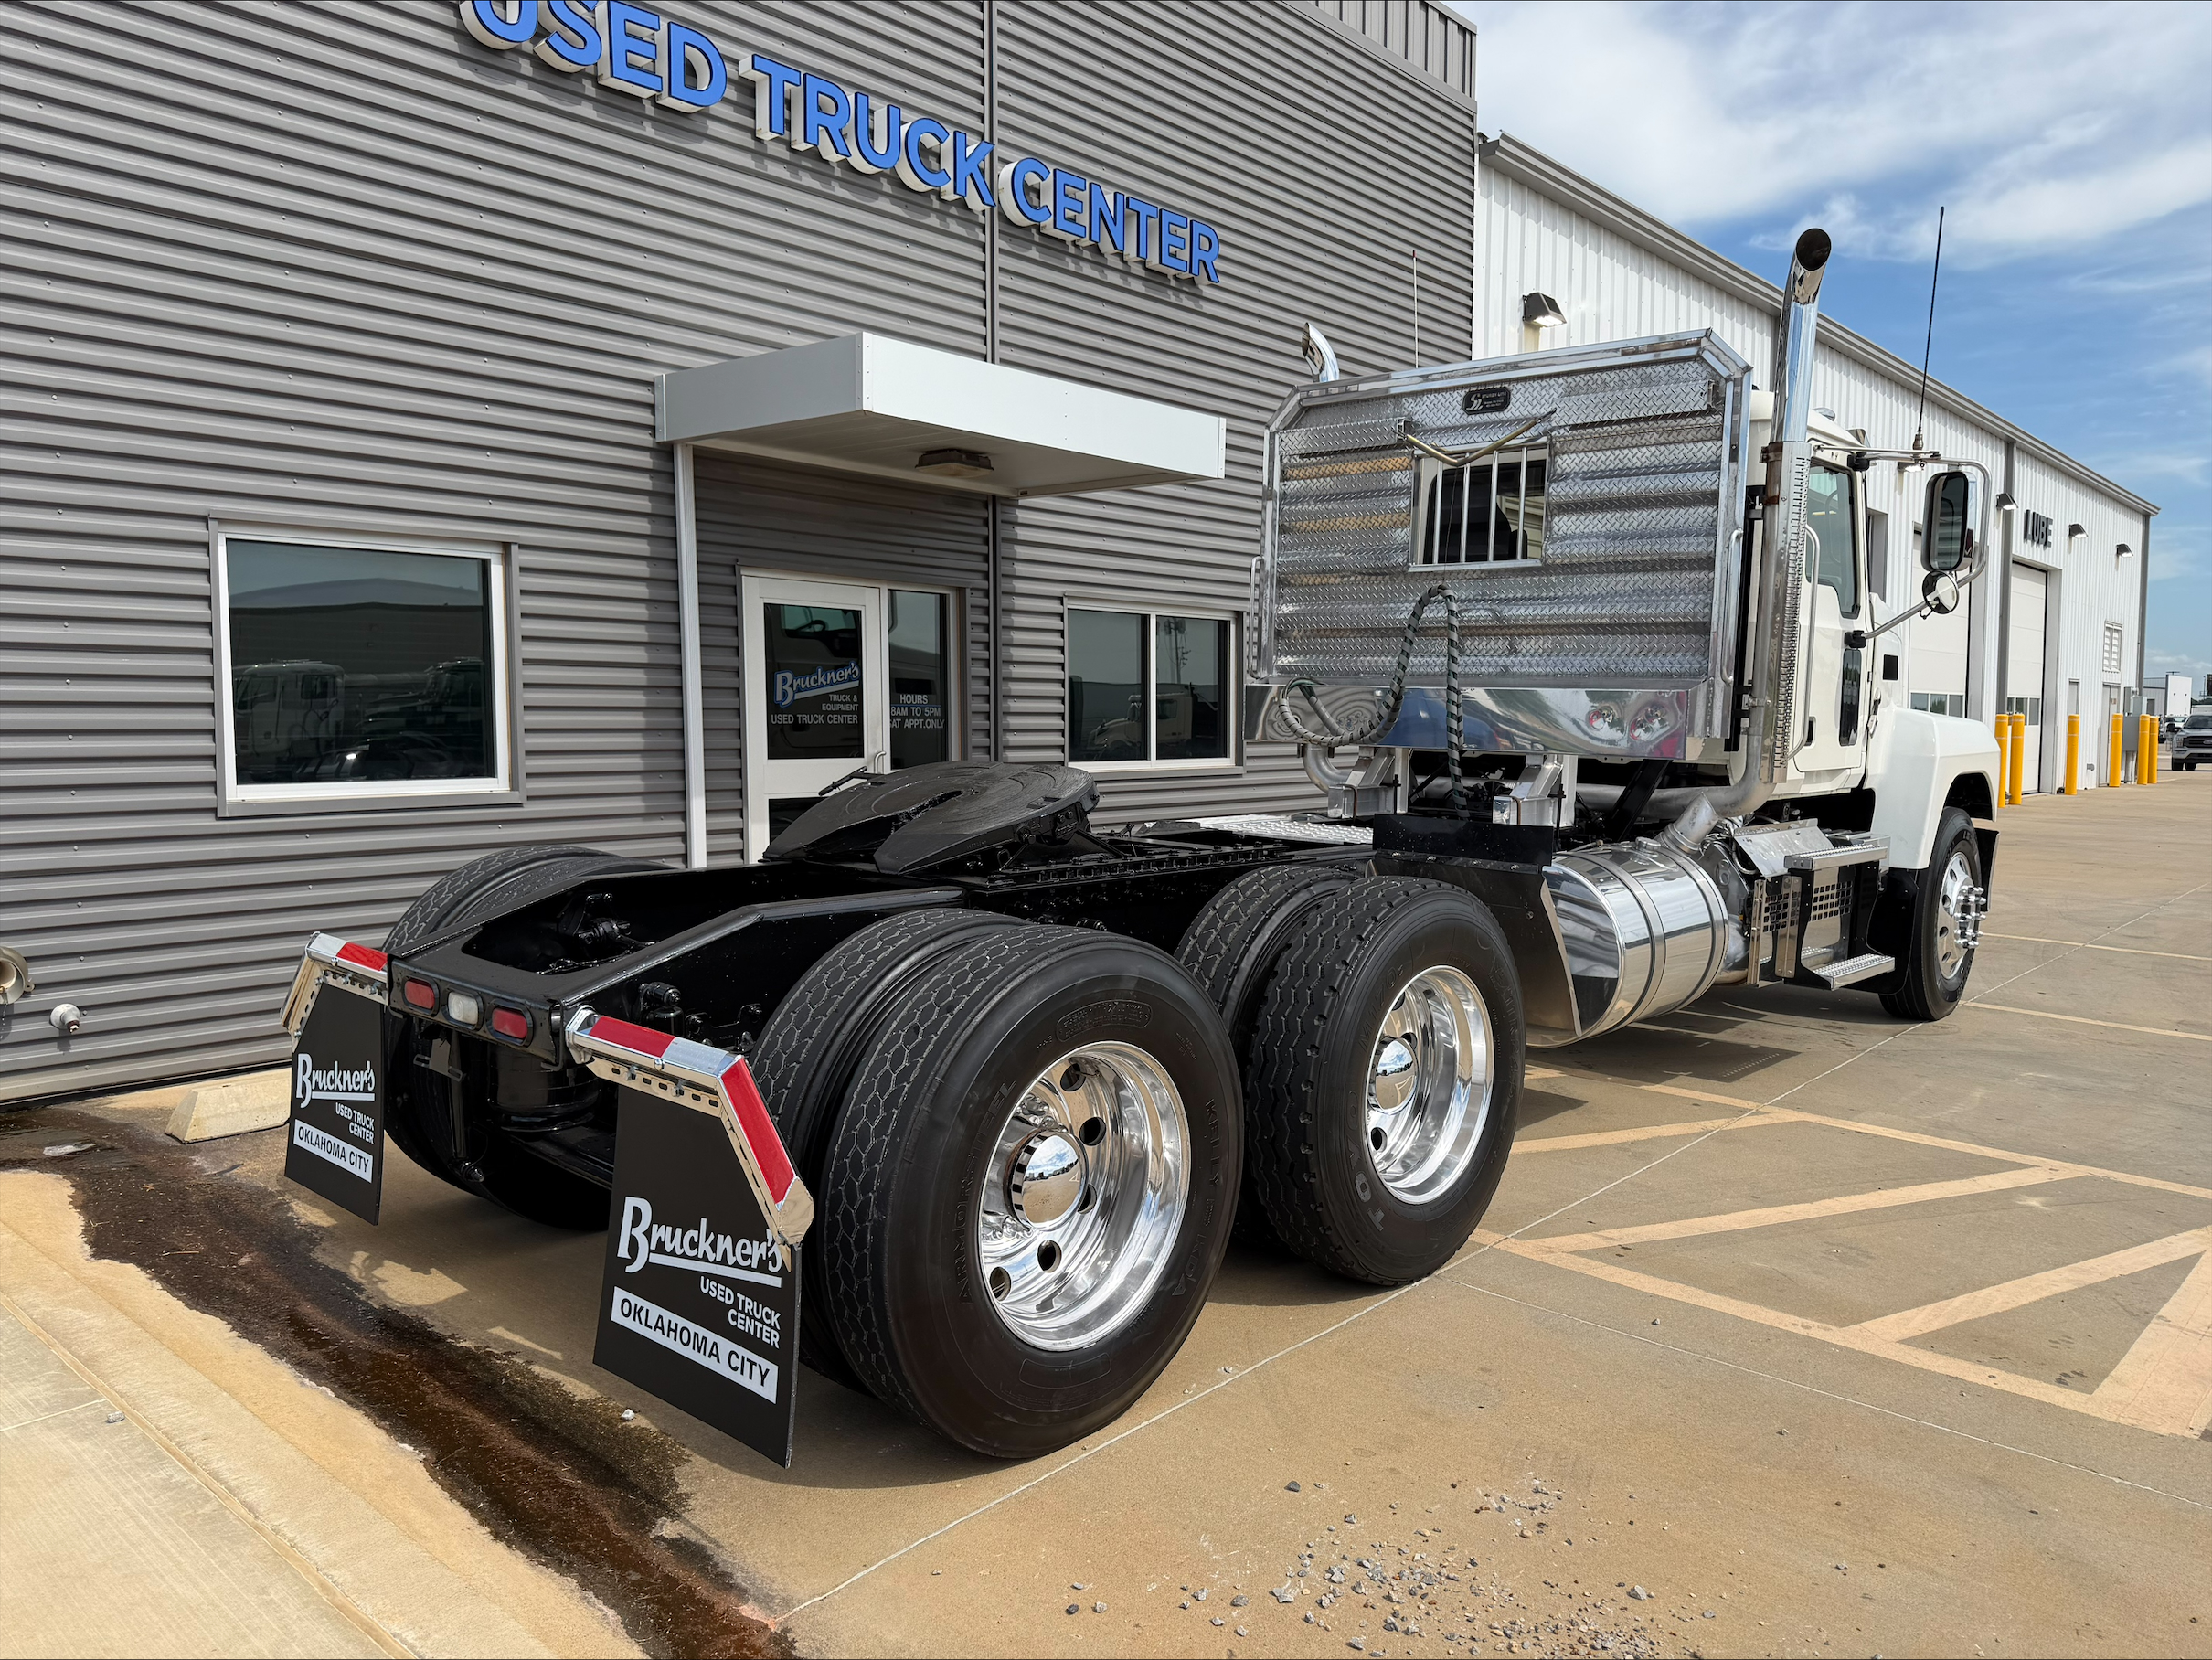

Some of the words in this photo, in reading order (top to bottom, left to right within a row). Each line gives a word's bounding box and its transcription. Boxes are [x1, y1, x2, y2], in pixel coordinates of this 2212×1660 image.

[751, 53, 996, 208] TRUCK
[1010, 156, 1221, 284] CENTER
[2023, 509, 2054, 548] LUBE
[774, 662, 860, 707] Bruckner's
[828, 694, 851, 702] TRUCK
[899, 694, 929, 705] HOURS
[771, 714, 794, 725] USED
[796, 714, 824, 725] TRUCK
[826, 714, 858, 725] CENTER
[822, 703, 859, 711] EQUIPMENT
[890, 706, 909, 717] 8AM
[910, 707, 922, 717] TO
[924, 707, 941, 717] 5PM
[295, 1053, 376, 1109] Bruckner's
[335, 1101, 353, 1120] USED
[353, 1109, 375, 1132] TRUCK
[348, 1121, 375, 1144] CENTER
[298, 1125, 346, 1163] OKLAHOMA
[348, 1150, 369, 1173] CITY
[616, 1196, 782, 1274] Bruckner's
[699, 1275, 735, 1305] USED
[736, 1292, 782, 1330] TRUCK
[620, 1297, 721, 1365] OKLAHOMA
[727, 1349, 771, 1388] CITY
[727, 1308, 781, 1350] CENTER
